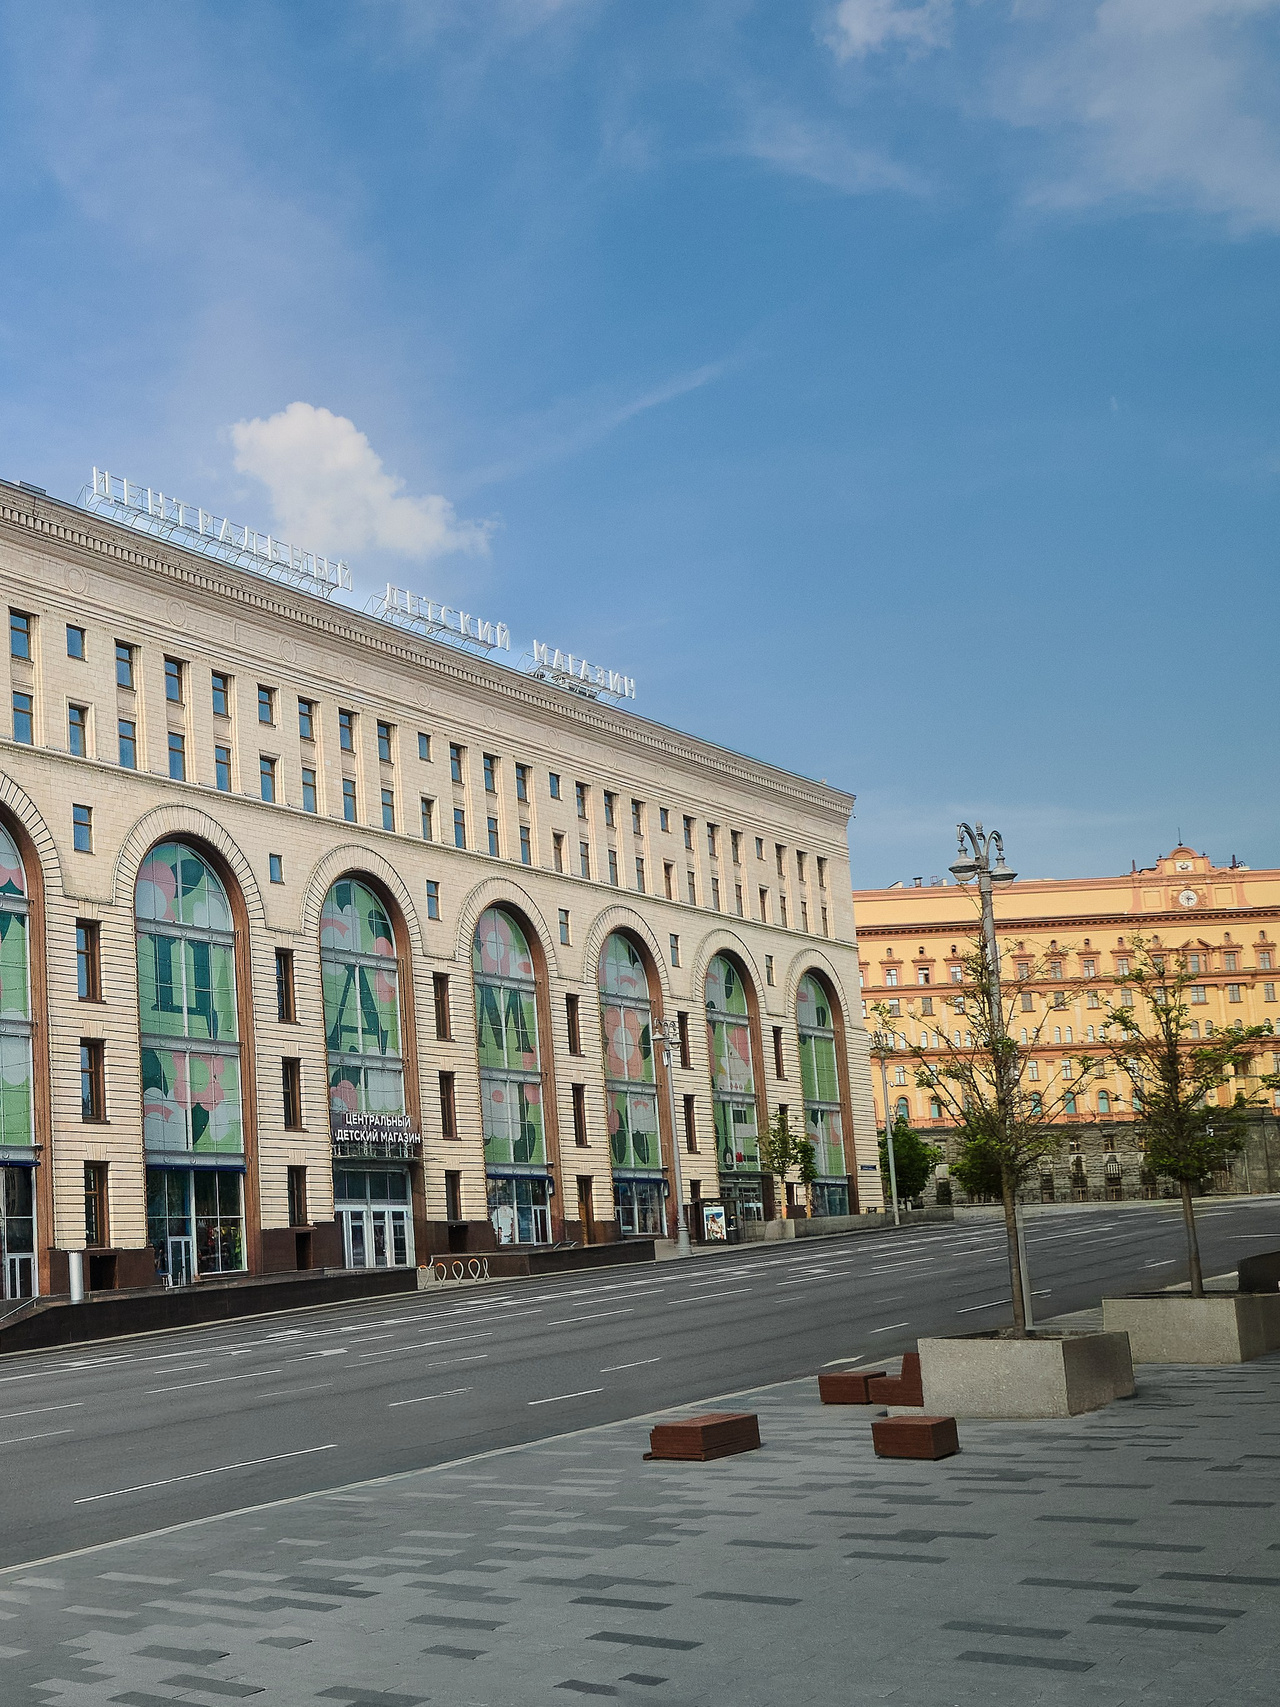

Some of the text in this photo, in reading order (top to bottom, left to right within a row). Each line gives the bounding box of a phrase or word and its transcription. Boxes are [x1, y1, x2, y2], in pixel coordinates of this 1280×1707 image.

[93, 466, 635, 700] ЦЕНТРАЛЬНЫЙ ДЕТСКИЙ МАГАЗИН
[345, 1113, 411, 1128] ЦЕНТРАЛЬНЫЙ
[335, 1129, 421, 1144] ДЕТСКИЙ МАГАЗИН
